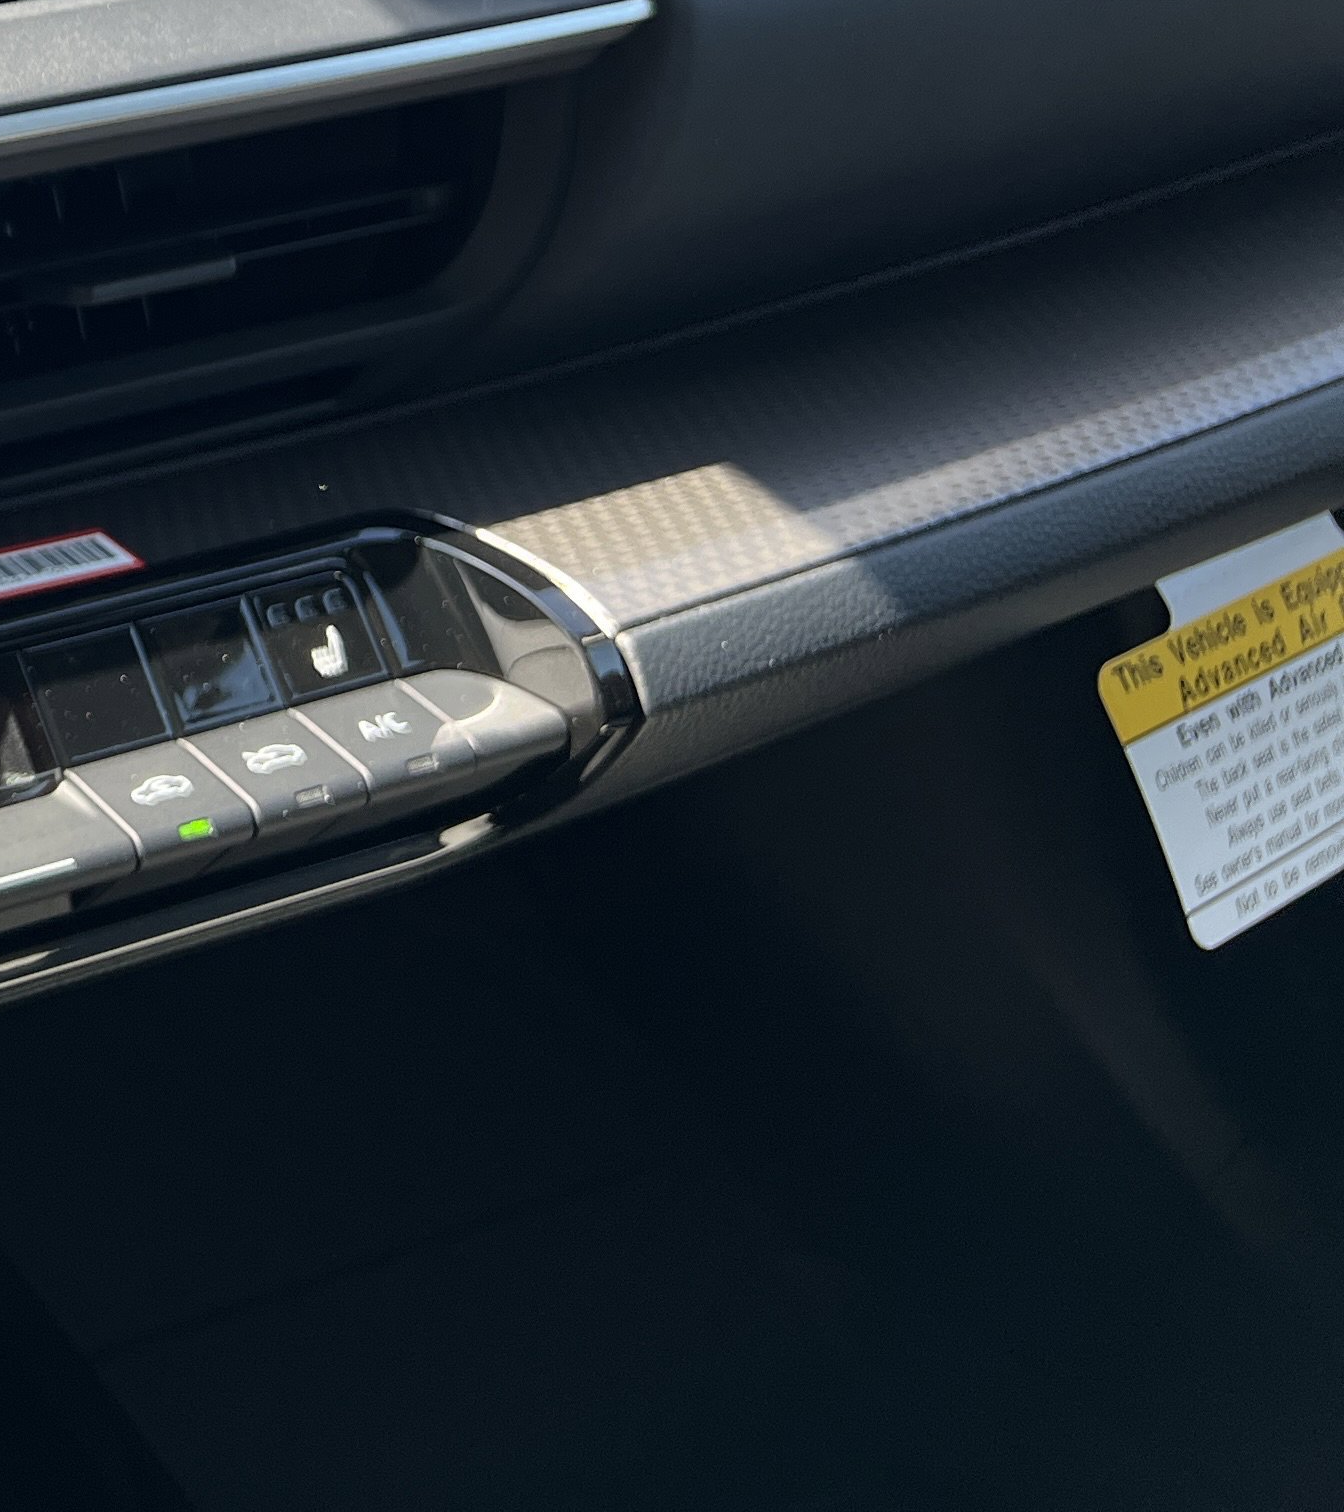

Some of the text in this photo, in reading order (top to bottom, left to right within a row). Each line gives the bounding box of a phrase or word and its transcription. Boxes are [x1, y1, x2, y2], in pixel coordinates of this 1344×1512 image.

[1111, 652, 1163, 694] This
[1167, 612, 1248, 666] Vehicle
[1179, 626, 1287, 704] Advanced
[358, 711, 411, 742] A/C
[1177, 712, 1221, 748] Even
